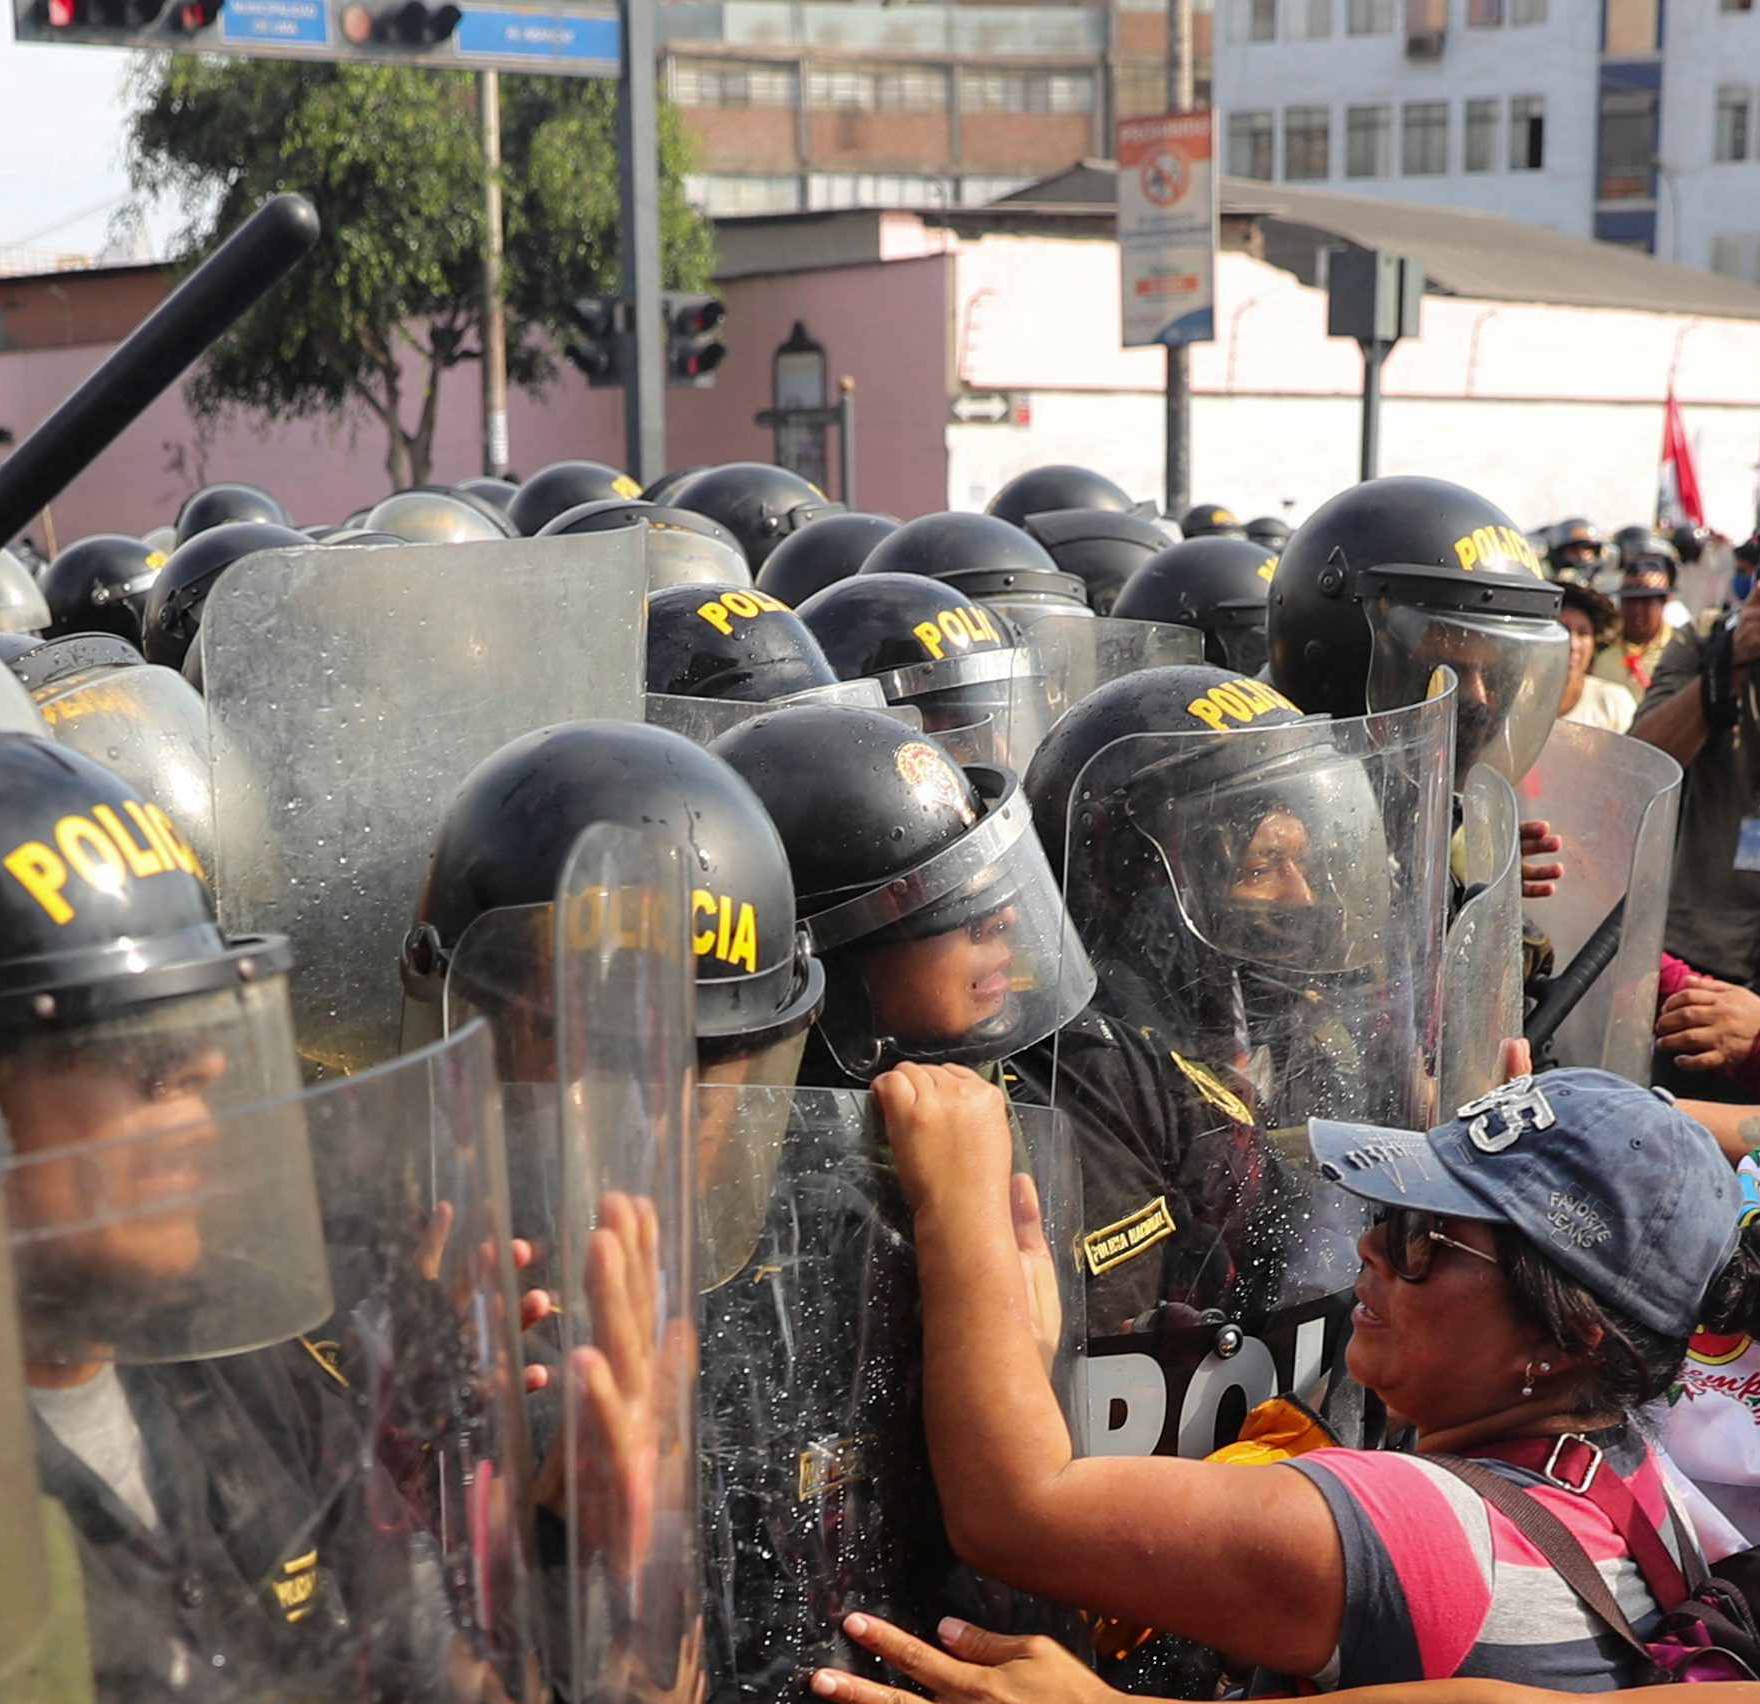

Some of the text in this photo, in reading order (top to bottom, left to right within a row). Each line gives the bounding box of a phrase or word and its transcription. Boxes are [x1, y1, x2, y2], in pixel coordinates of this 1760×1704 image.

[696, 589, 802, 636] POLI
[1187, 678, 1305, 731] POLICI
[2, 799, 207, 927] POLIC
[1546, 1211, 1595, 1249] JEANS
[1548, 1190, 1613, 1244] FAVORITE
